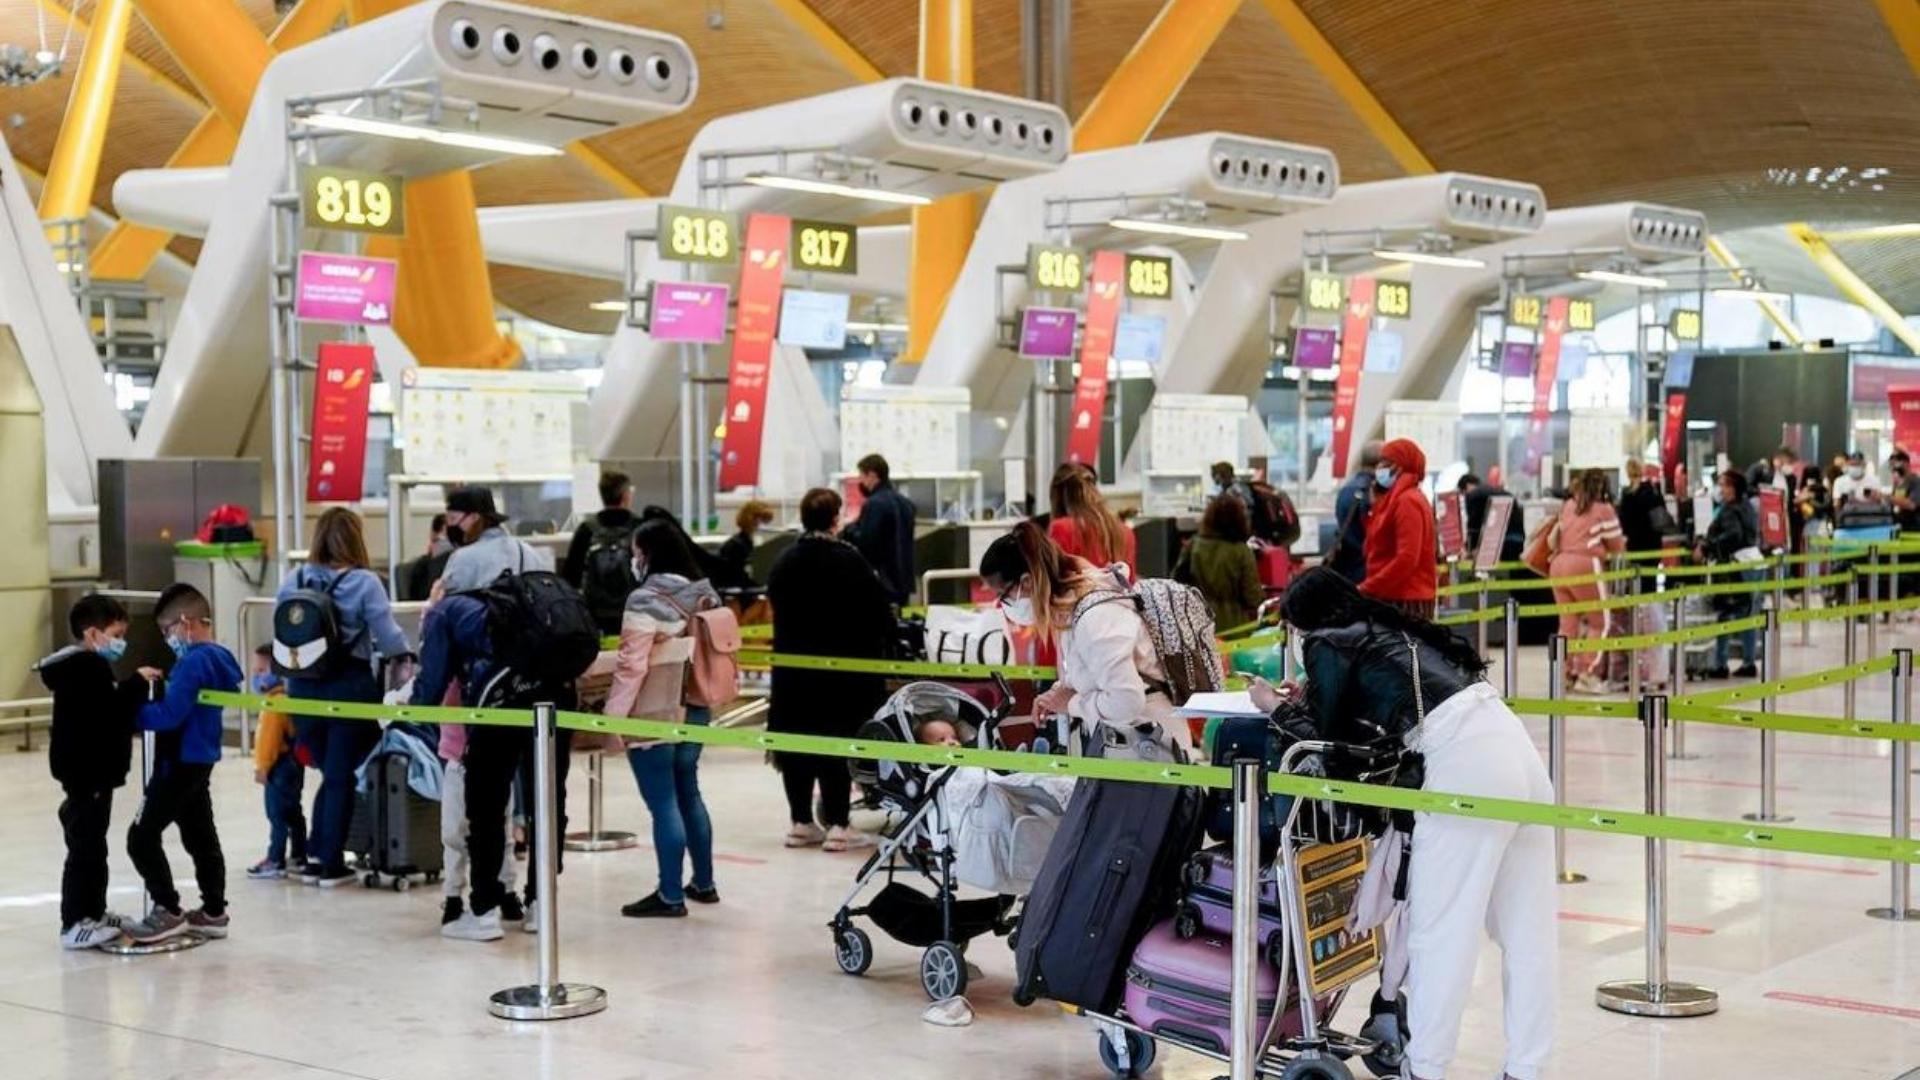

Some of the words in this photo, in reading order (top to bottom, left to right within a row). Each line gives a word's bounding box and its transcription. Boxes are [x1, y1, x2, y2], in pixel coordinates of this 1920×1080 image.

[317, 177, 391, 226] 819
[672, 216, 728, 257] 818
[800, 229, 848, 267] 817
[1039, 251, 1080, 288] 816
[1129, 260, 1168, 295] 815
[1378, 285, 1408, 315] 813
